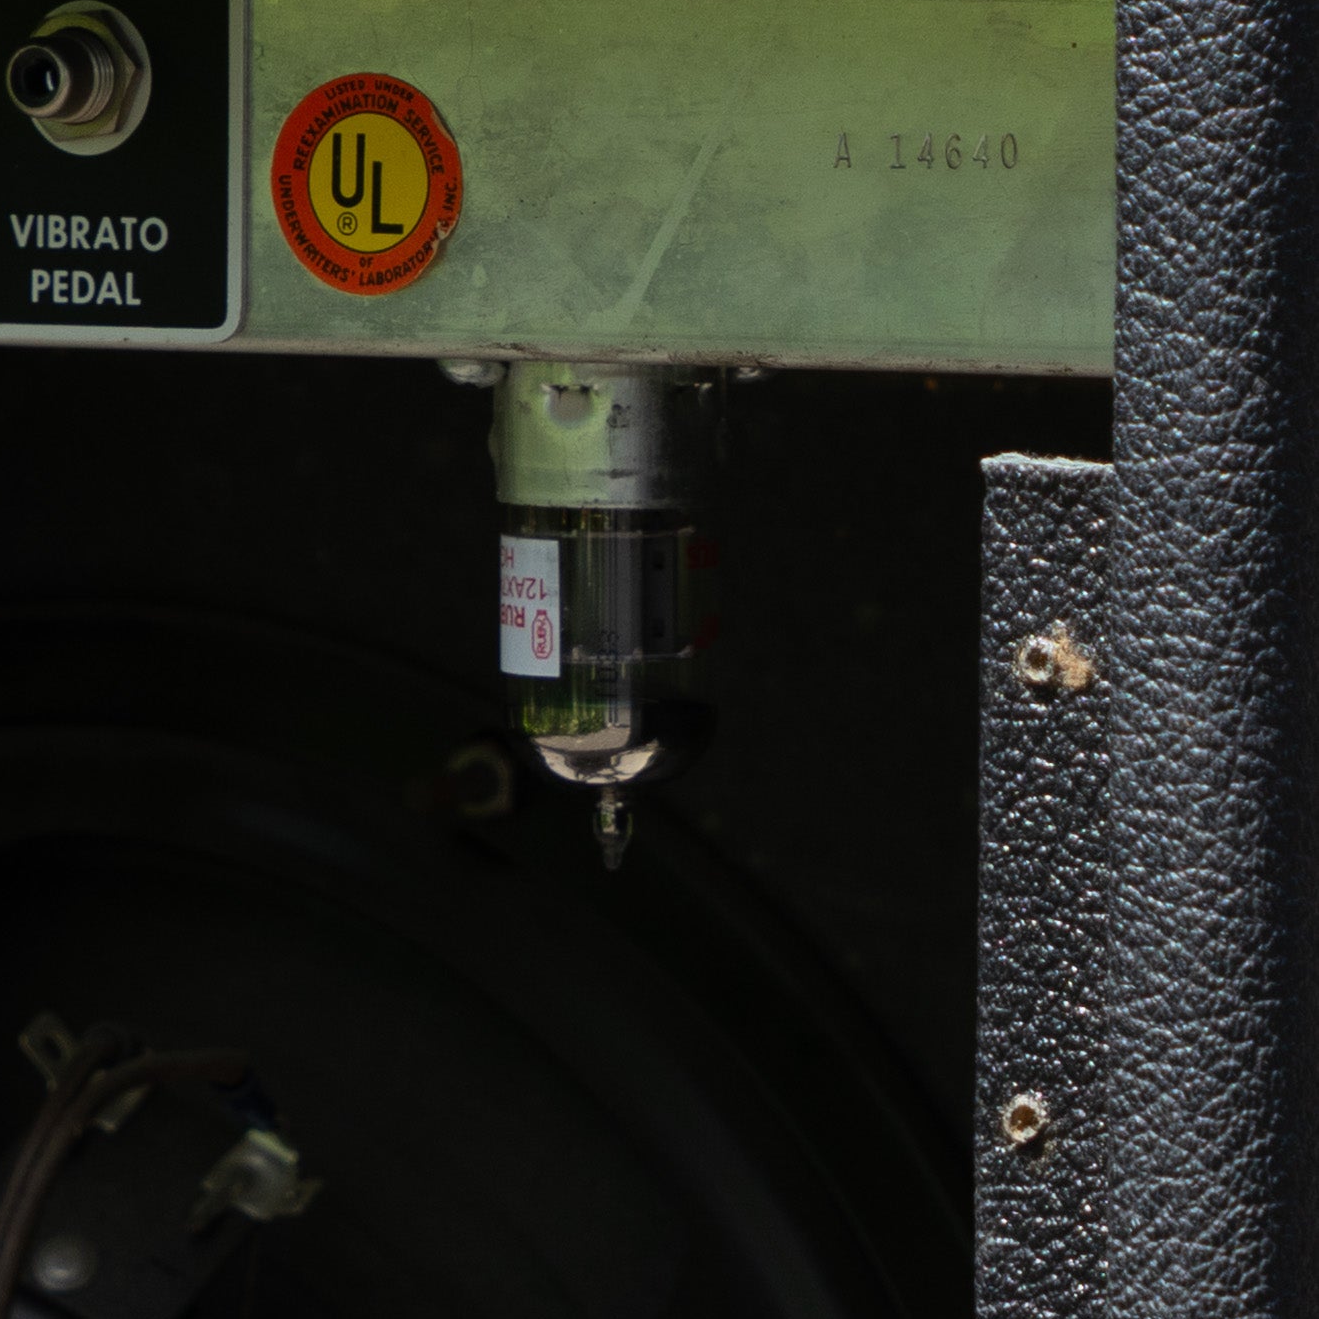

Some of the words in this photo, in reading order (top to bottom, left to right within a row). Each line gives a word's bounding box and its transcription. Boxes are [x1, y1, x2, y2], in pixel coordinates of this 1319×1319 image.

[324, 80, 366, 101] LISTED
[374, 80, 415, 102] UNDER
[293, 93, 399, 171] REEXAMINATION
[403, 109, 445, 175] SERVICE
[832, 131, 853, 169] A
[888, 131, 1019, 170] 14640
[331, 132, 405, 235] UL
[442, 176, 458, 212] INC.
[9, 213, 170, 253] VIBRATO
[359, 256, 374, 267] OF
[31, 268, 142, 306] PEDAL
